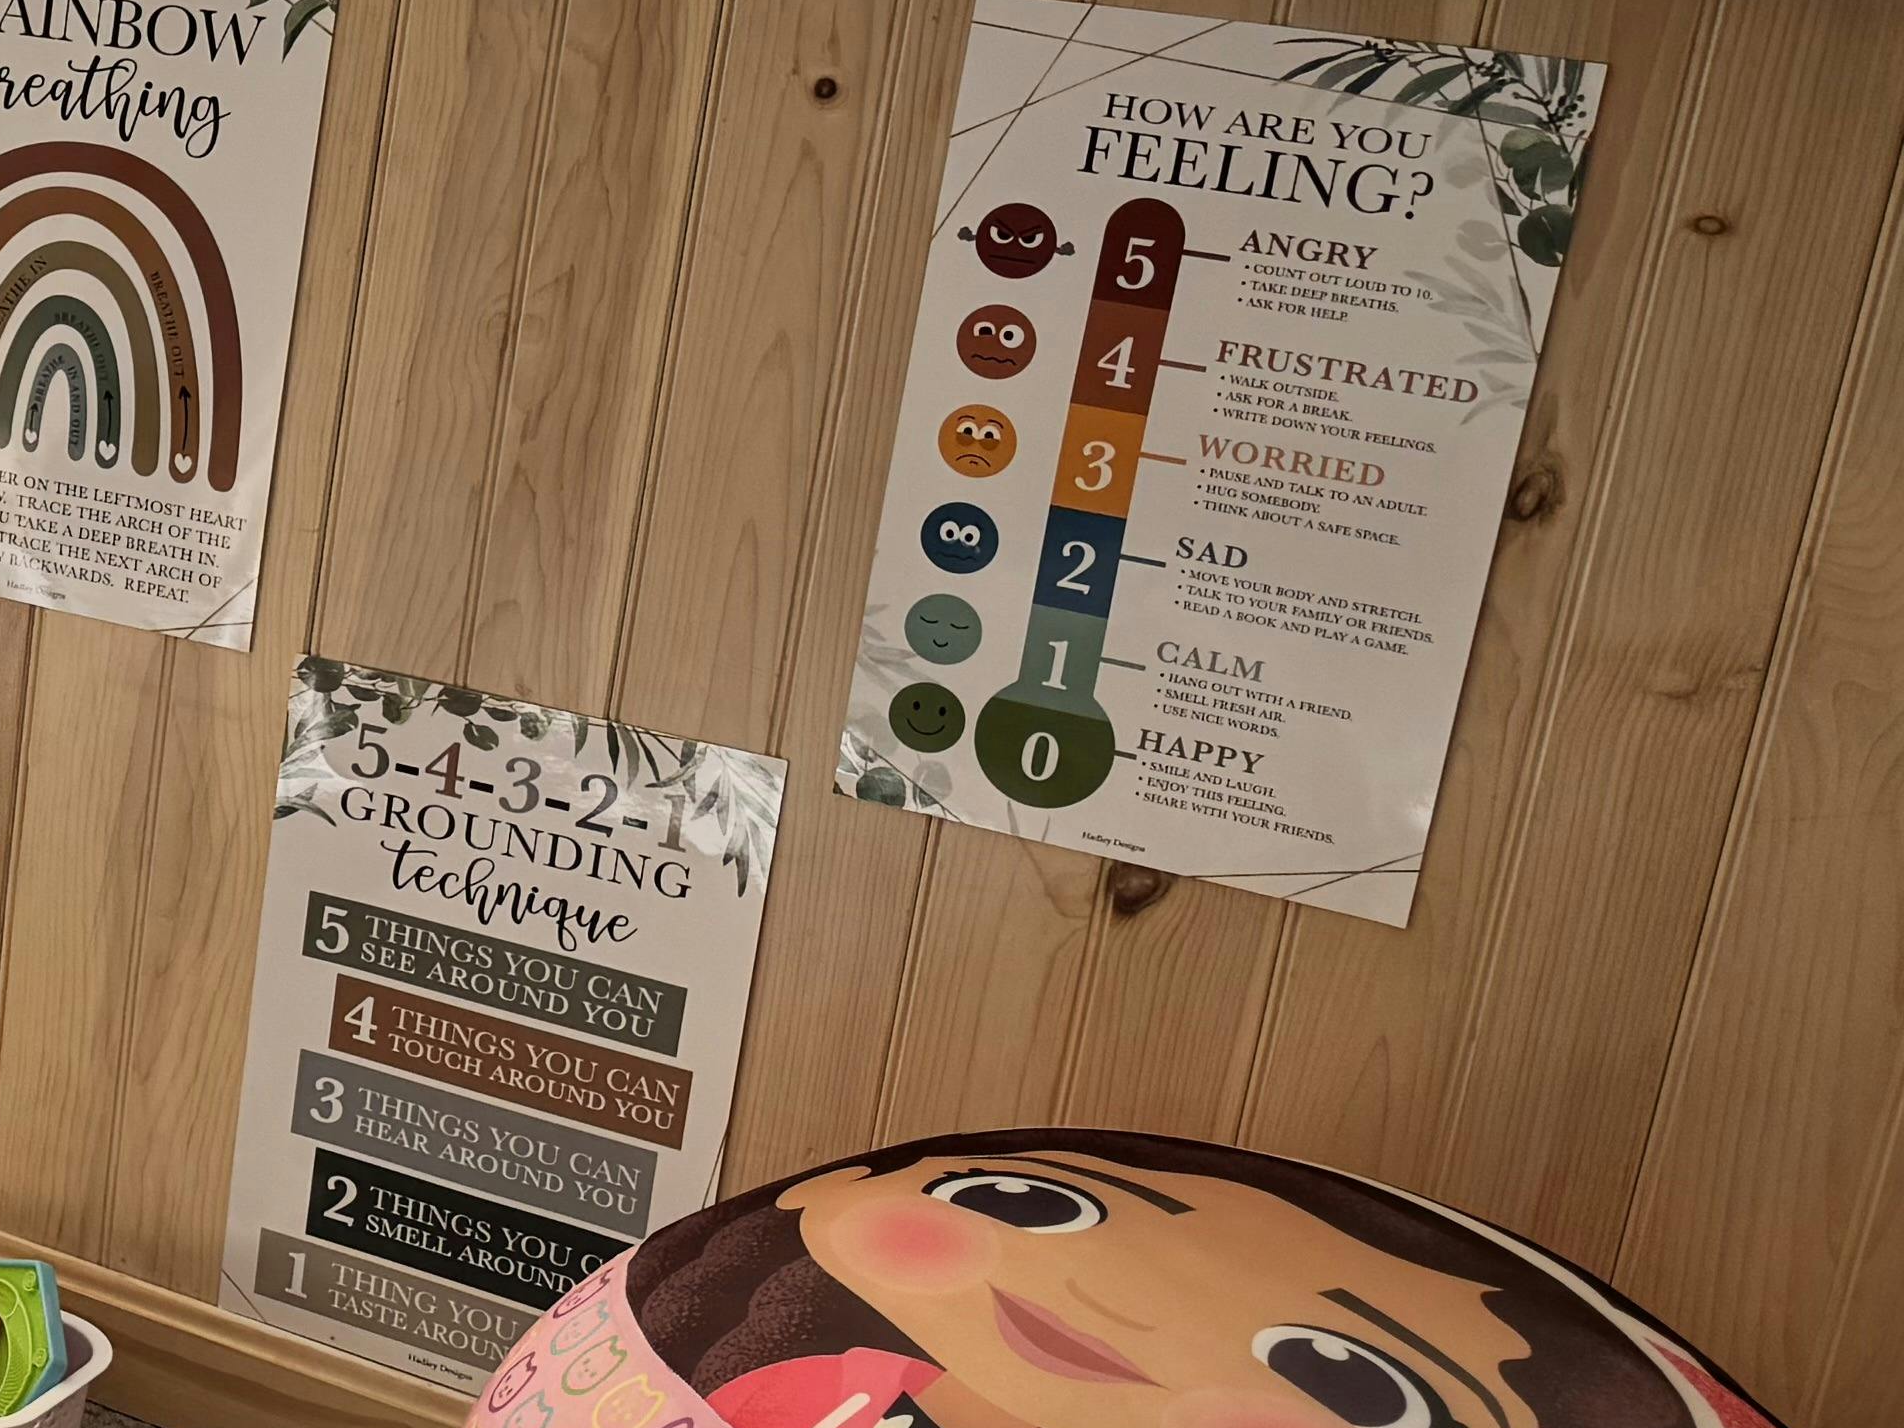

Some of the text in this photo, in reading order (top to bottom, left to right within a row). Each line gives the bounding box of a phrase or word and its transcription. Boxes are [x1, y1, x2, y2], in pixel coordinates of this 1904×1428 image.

[1103, 93, 1432, 159] HOW ARE YOU
[1077, 125, 1434, 220] FEELING?
[1239, 229, 1379, 270] ANGRY
[1250, 280, 1400, 313] TAKE DEEP BREATHS.
[1215, 339, 1480, 404] FRUSTRATED
[1225, 390, 1353, 423] ASK FOR A BREAK.
[1198, 433, 1386, 487] WORRIED
[23, 474, 49, 492] ON
[53, 480, 89, 501] THE
[93, 488, 186, 519] LEFTMOST
[189, 506, 248, 532] HEART
[1175, 536, 1248, 569] SAD
[1156, 640, 1267, 683] CALM
[1137, 728, 1265, 774] HAPPY
[350, 722, 687, 853] 5-4-3-2-1
[340, 786, 693, 899] GROUNDING
[379, 839, 638, 952] technique
[314, 904, 665, 1015] 5 THINGS YOU CAN
[360, 942, 656, 1039] SEE AROUND YOU
[343, 996, 681, 1108] 4 THINGS YOU CAN
[388, 1032, 676, 1130] TOUCH AROUND YOU
